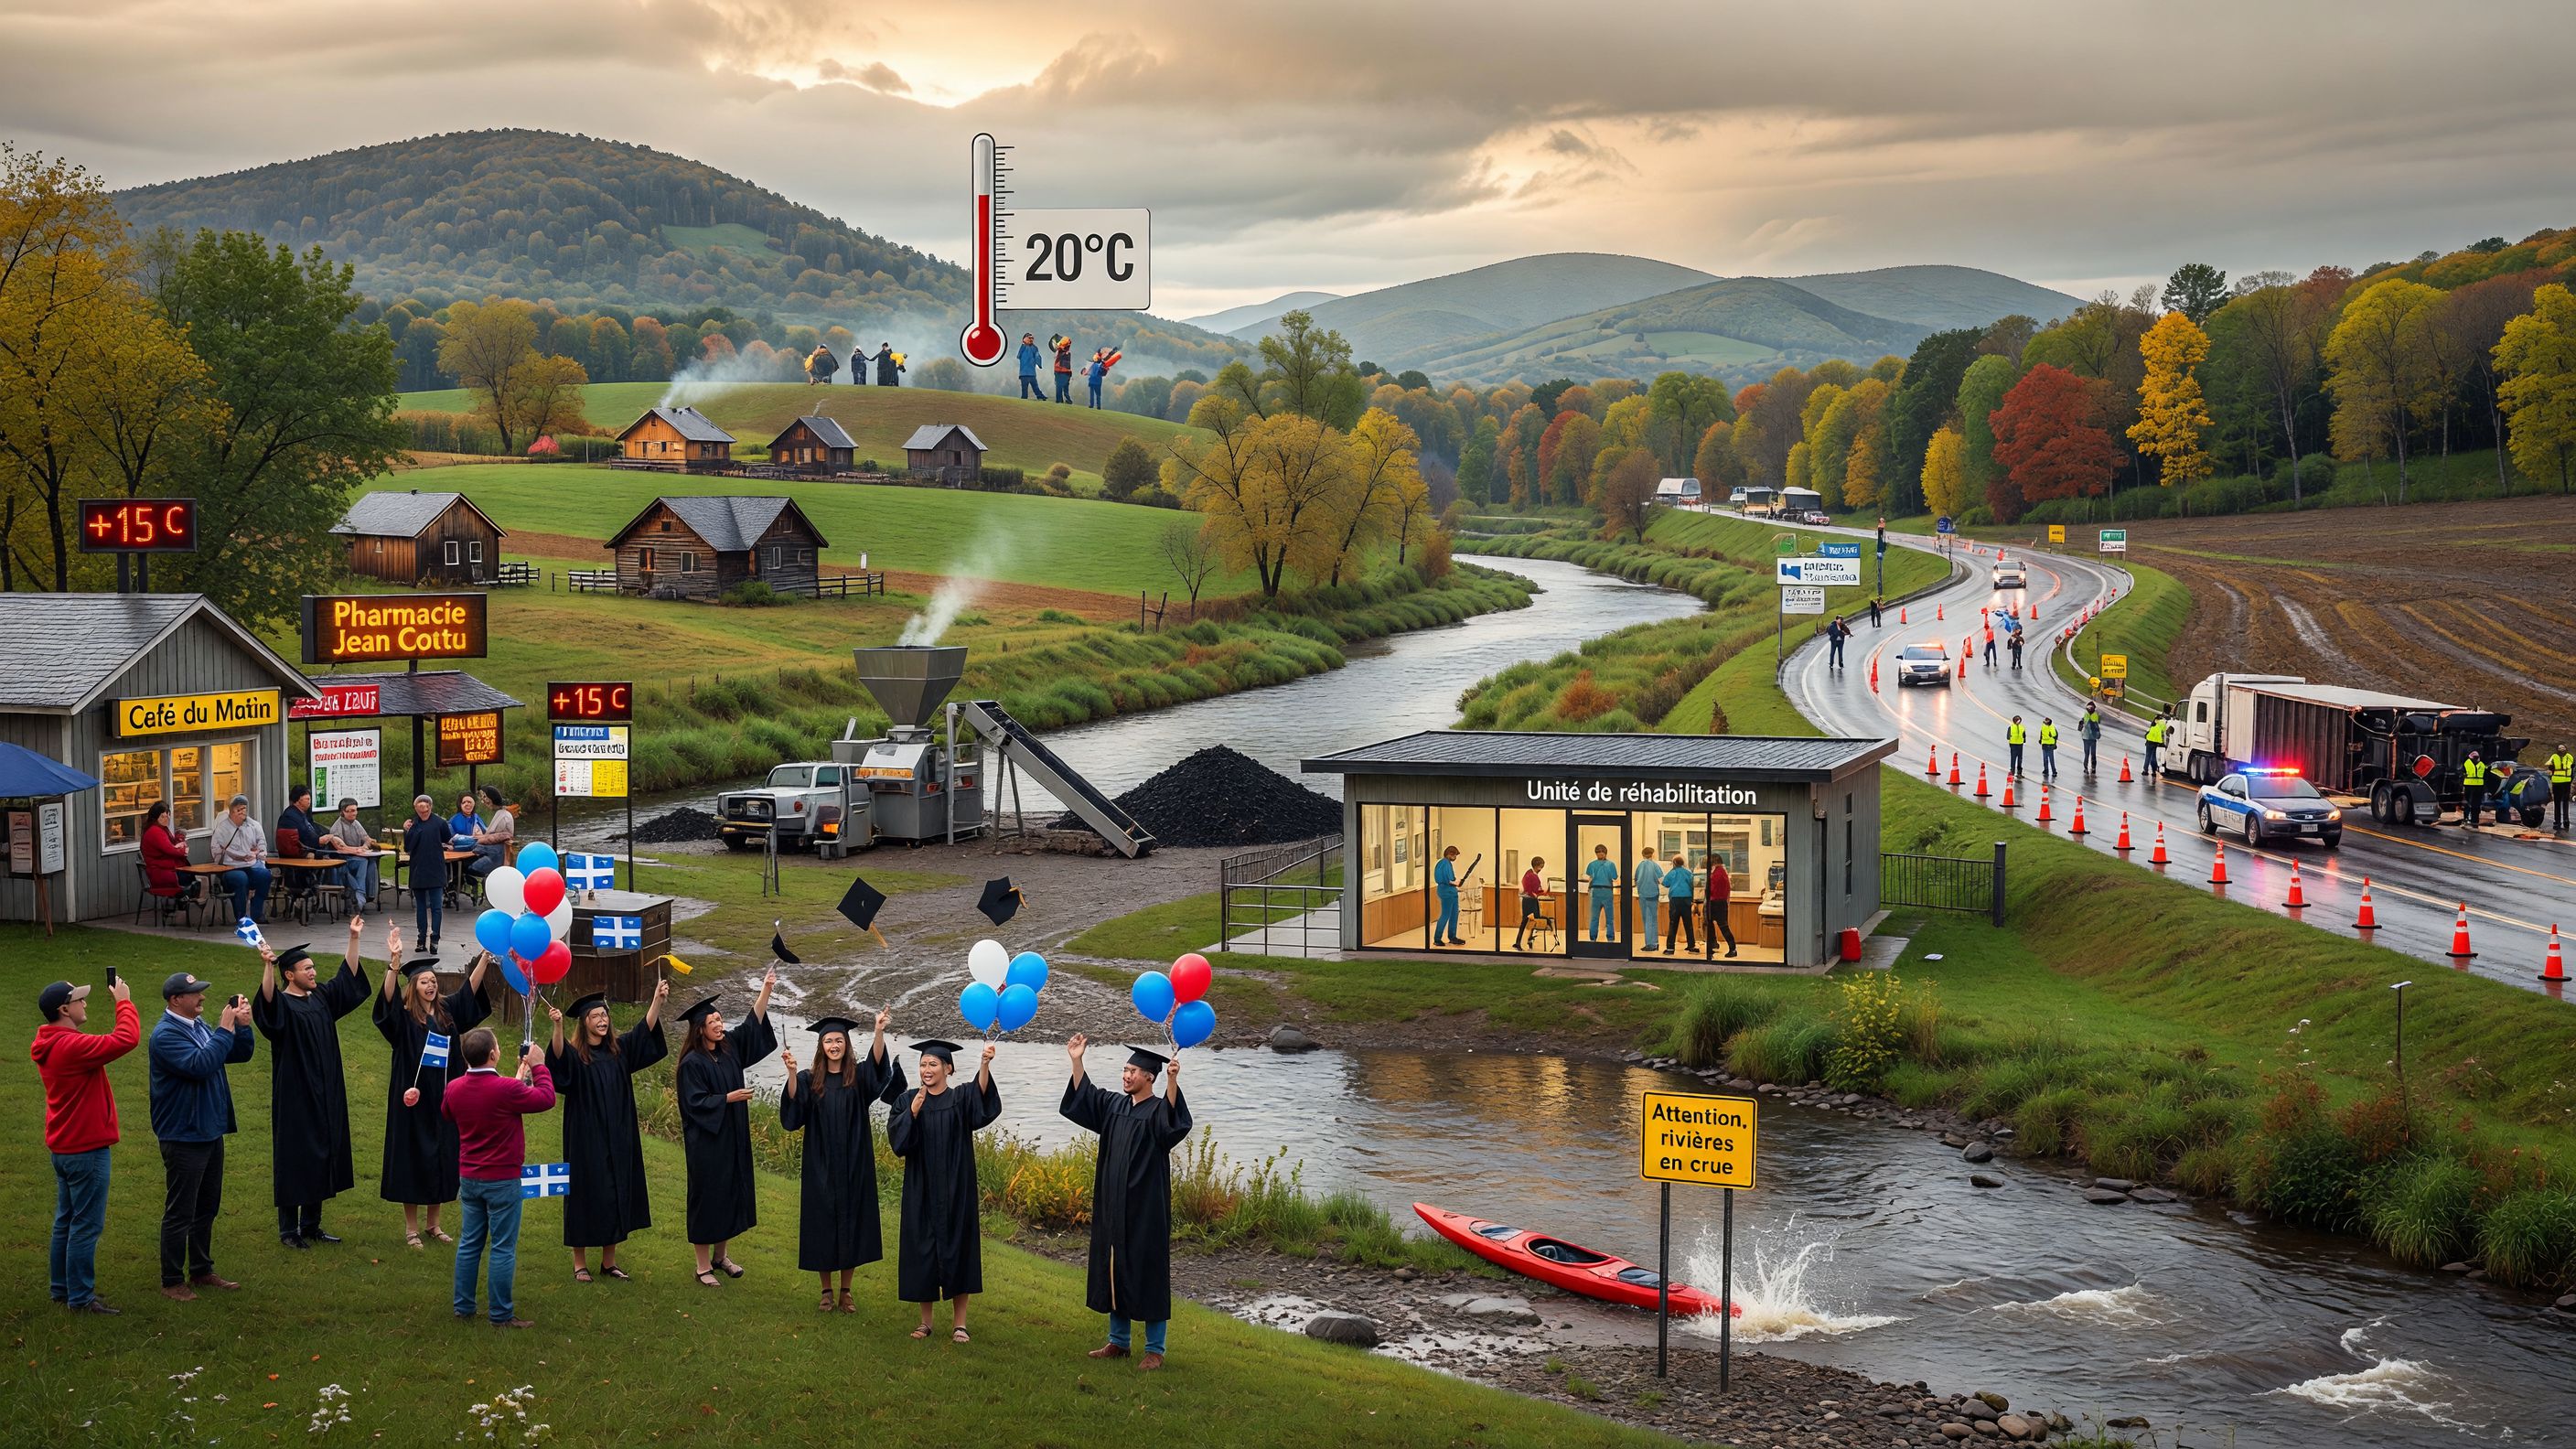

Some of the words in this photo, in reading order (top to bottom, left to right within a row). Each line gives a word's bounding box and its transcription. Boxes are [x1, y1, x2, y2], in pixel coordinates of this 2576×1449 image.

[89, 506, 153, 542] +15
[166, 506, 184, 534] C
[334, 600, 467, 627] Pharmacie
[332, 628, 391, 655] Jean
[184, 701, 208, 724] du
[553, 688, 602, 714] +15
[612, 687, 626, 708] C
[1527, 780, 1581, 801] Unité
[1587, 780, 1613, 802] de
[1619, 782, 1757, 805] réhabilitation
[1661, 1129, 1733, 1152] rivières
[1660, 1156, 1682, 1171] en
[1690, 1159, 1733, 1175] crue
